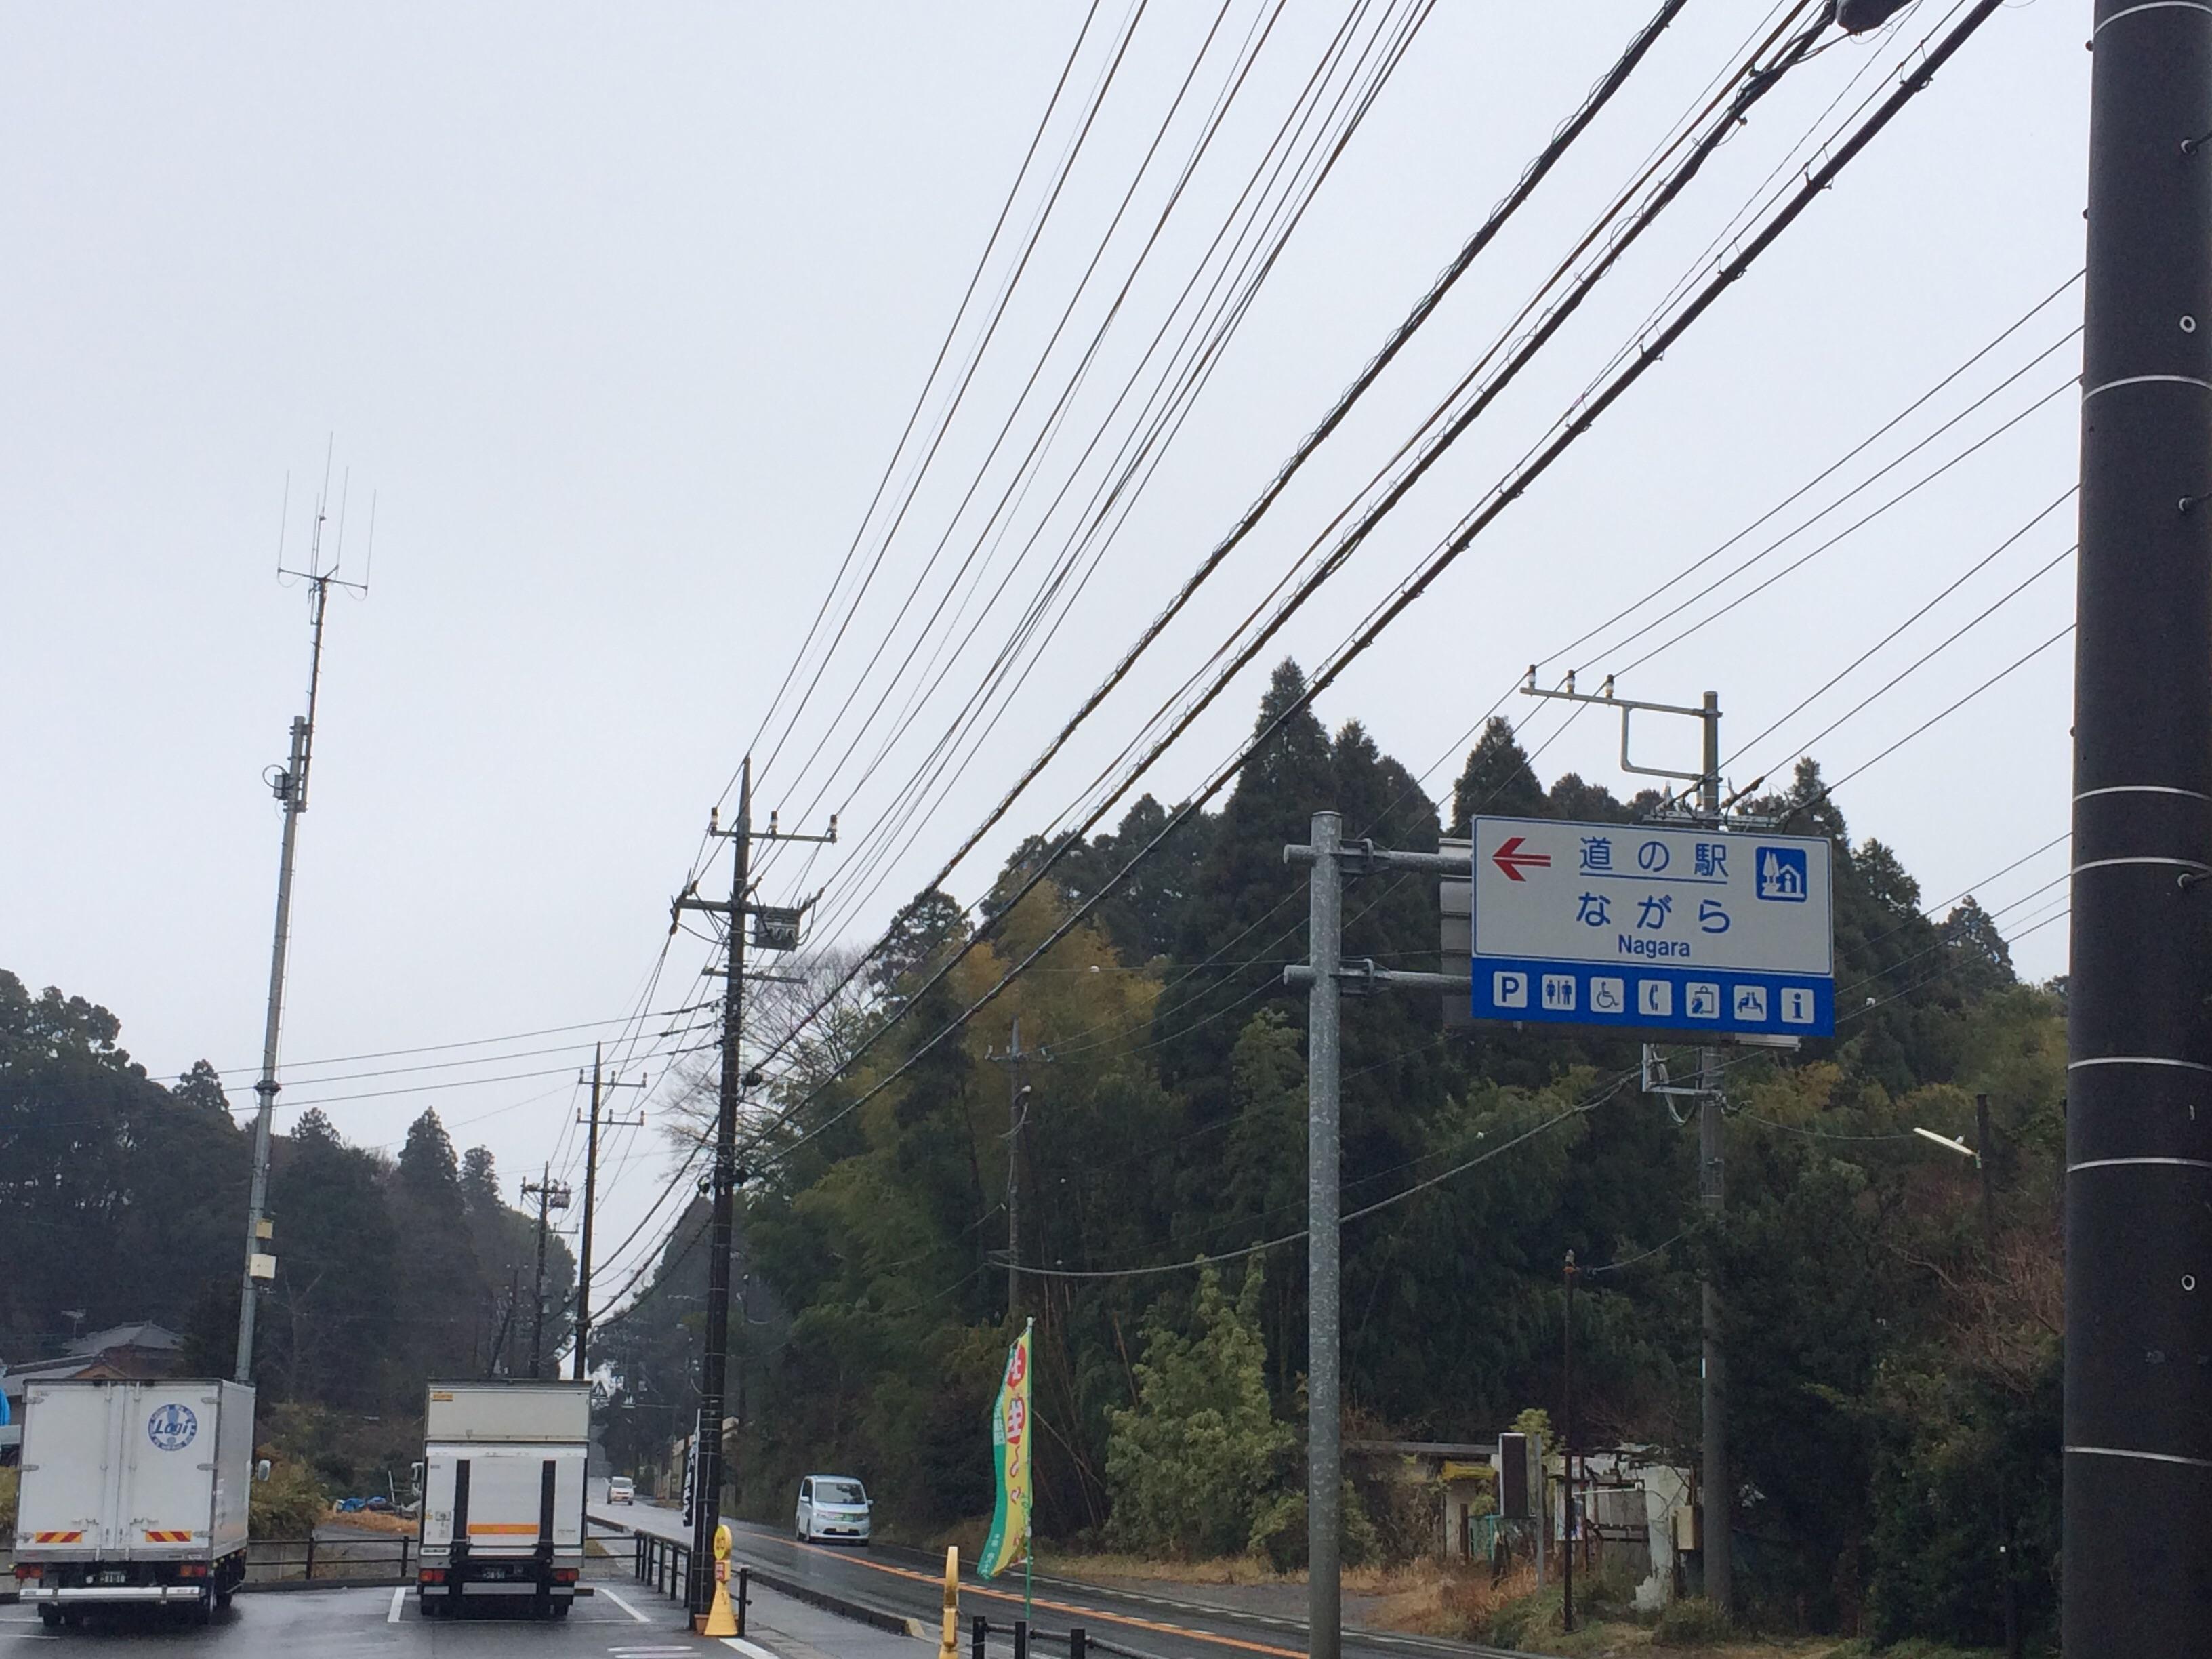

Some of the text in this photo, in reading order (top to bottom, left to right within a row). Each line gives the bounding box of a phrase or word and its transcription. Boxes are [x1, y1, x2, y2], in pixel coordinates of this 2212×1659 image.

[1579, 836, 1729, 878] 道の駅
[1576, 891, 1731, 933] ながら
[1618, 934, 1691, 958] Nagara
[152, 1419, 191, 1436] Logi
